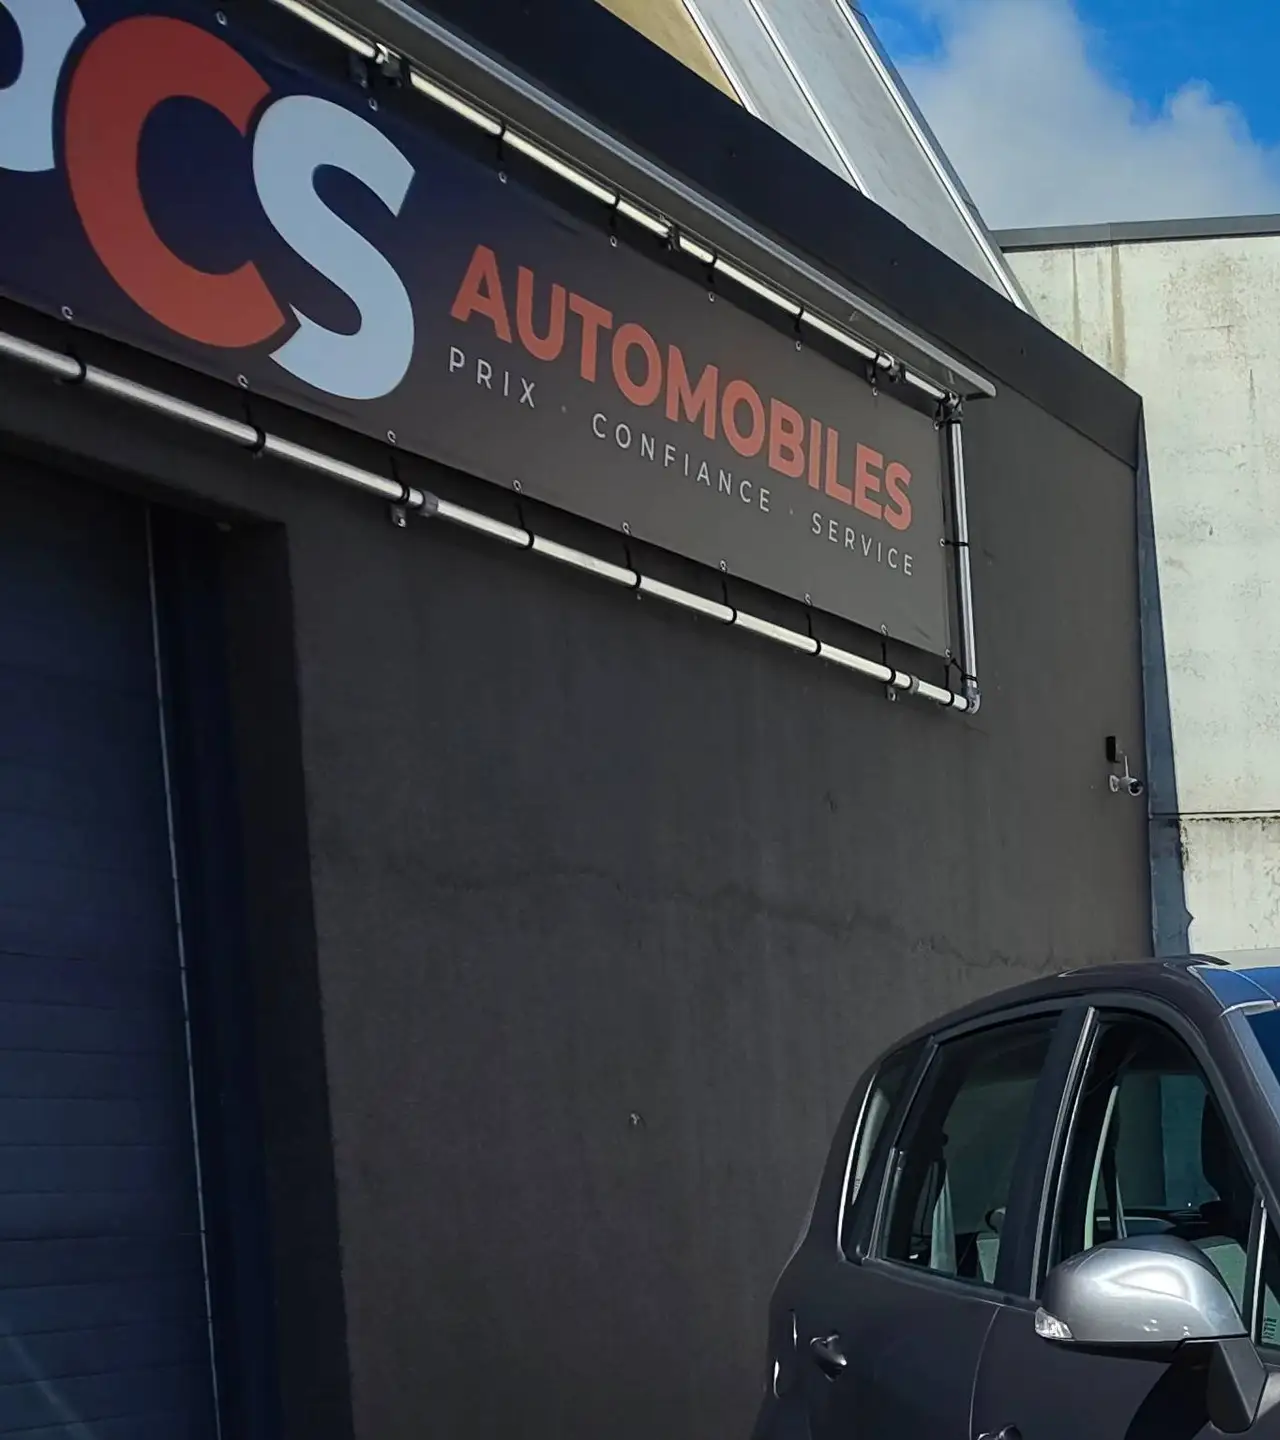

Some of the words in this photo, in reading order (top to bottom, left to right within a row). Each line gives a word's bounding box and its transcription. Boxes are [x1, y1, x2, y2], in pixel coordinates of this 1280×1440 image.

[449, 347, 538, 410] PRIX
[592, 413, 772, 513] CONFIANCE
[811, 511, 915, 577] SERVICE
[450, 245, 913, 531] AUTOMOBILES
